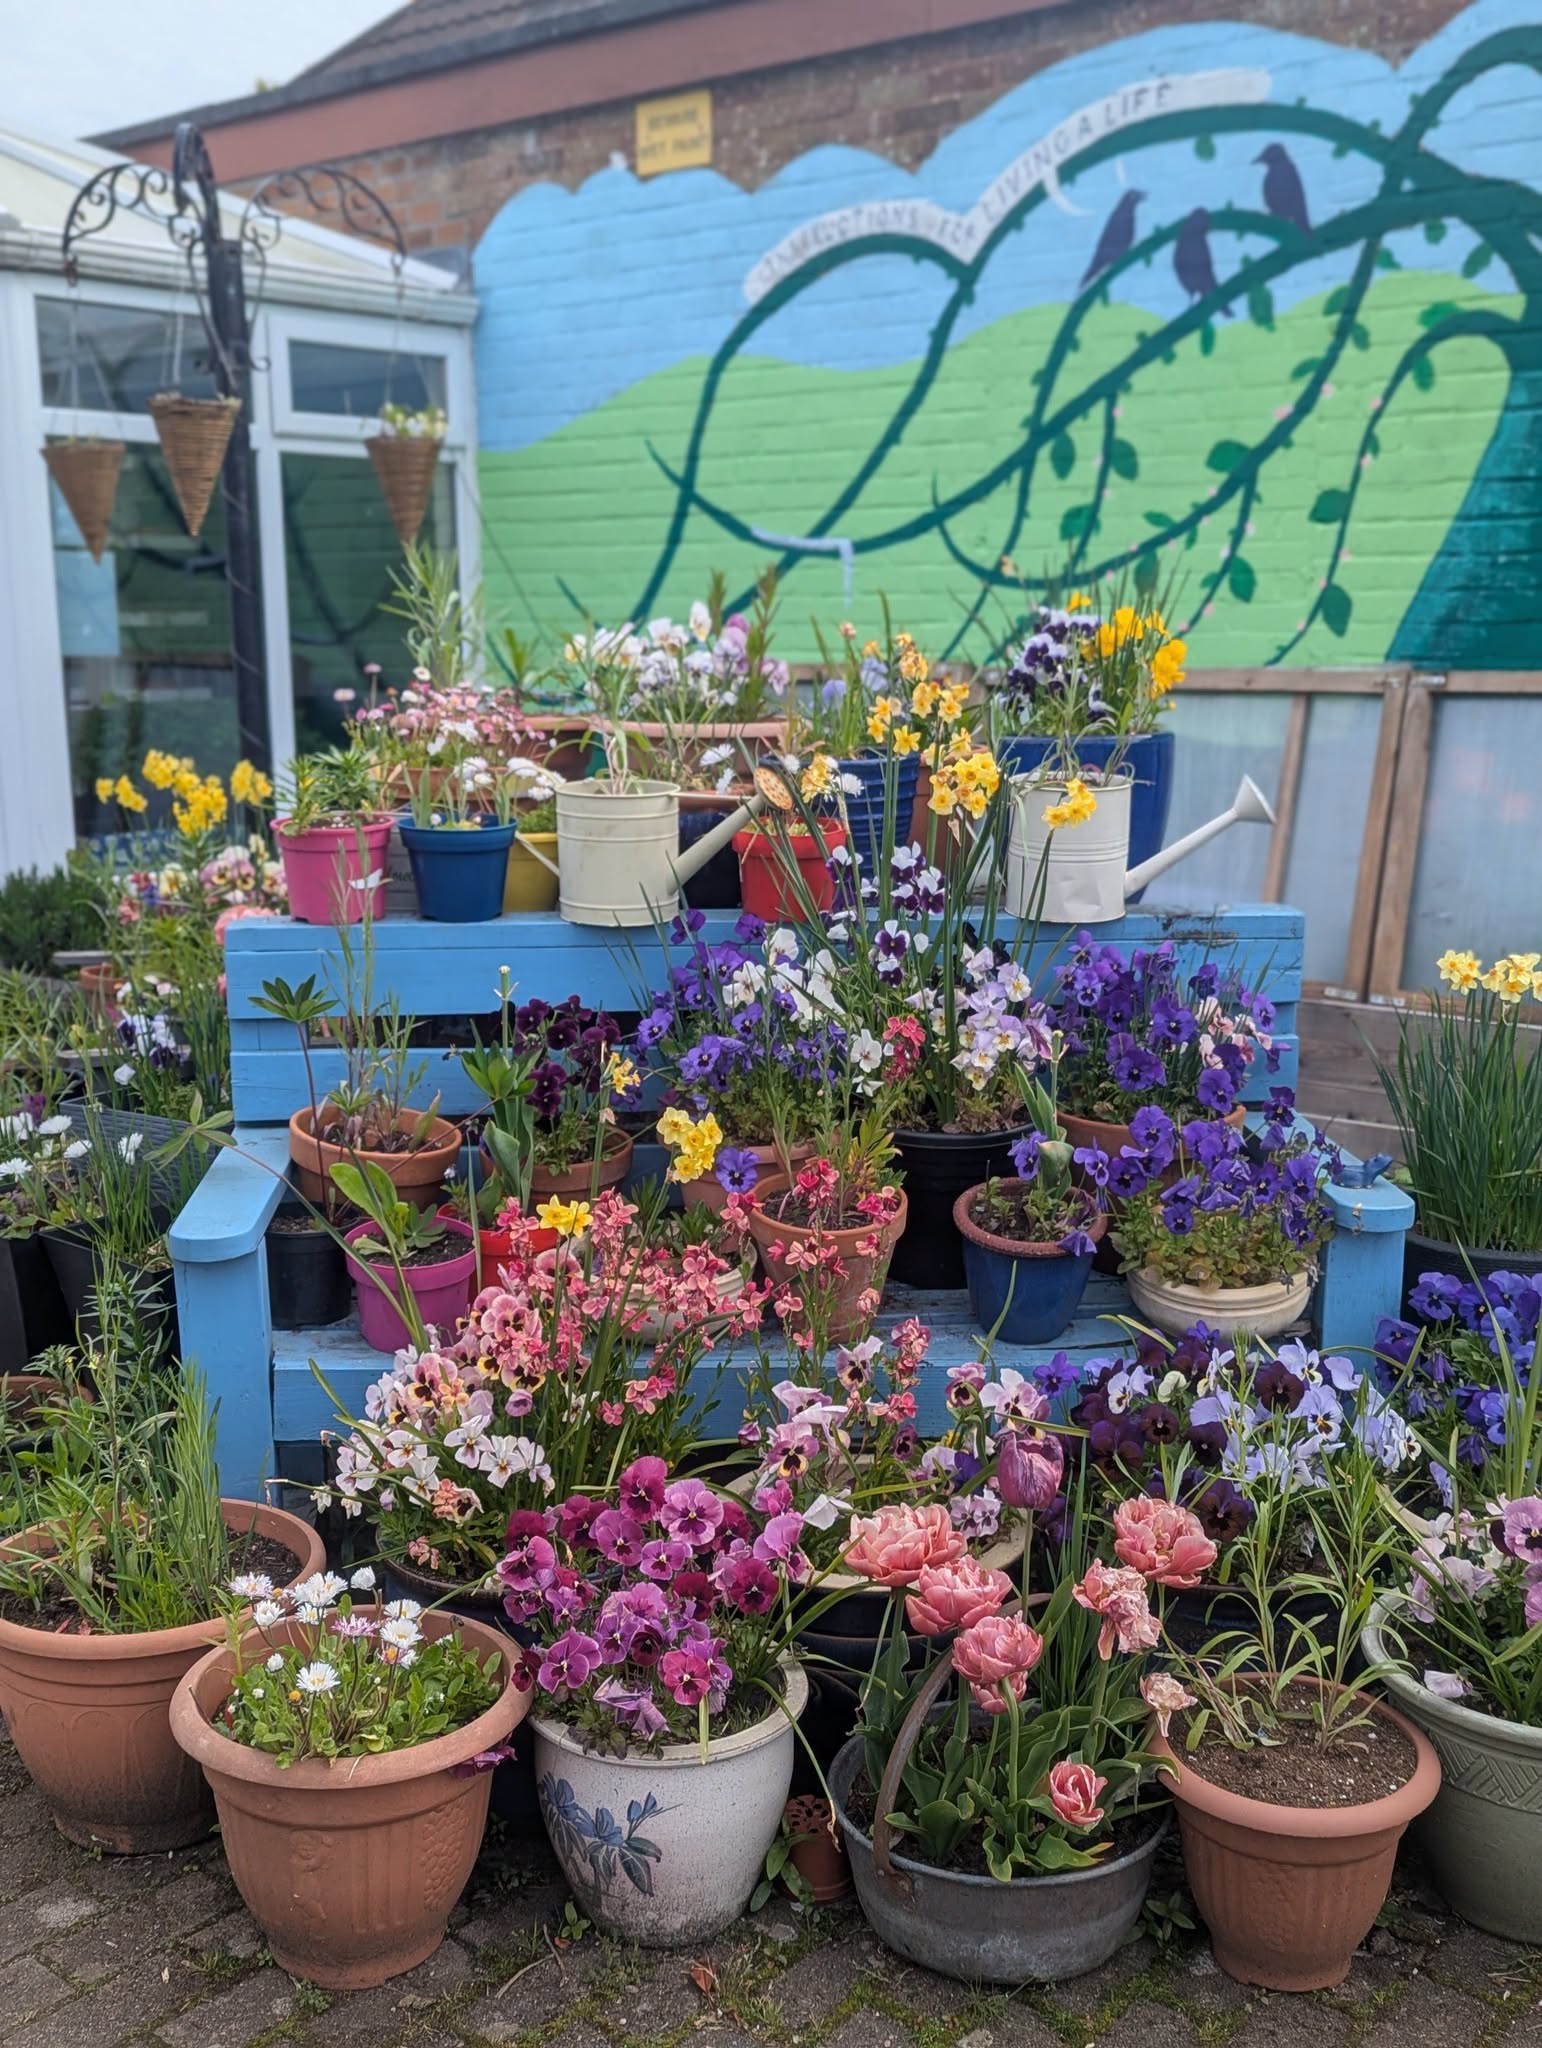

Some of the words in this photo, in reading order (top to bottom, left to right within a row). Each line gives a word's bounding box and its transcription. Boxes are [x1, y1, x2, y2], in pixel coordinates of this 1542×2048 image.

[982, 129, 1072, 224] LIVING
[1076, 114, 1093, 135] A
[1104, 81, 1172, 128] LIFE
